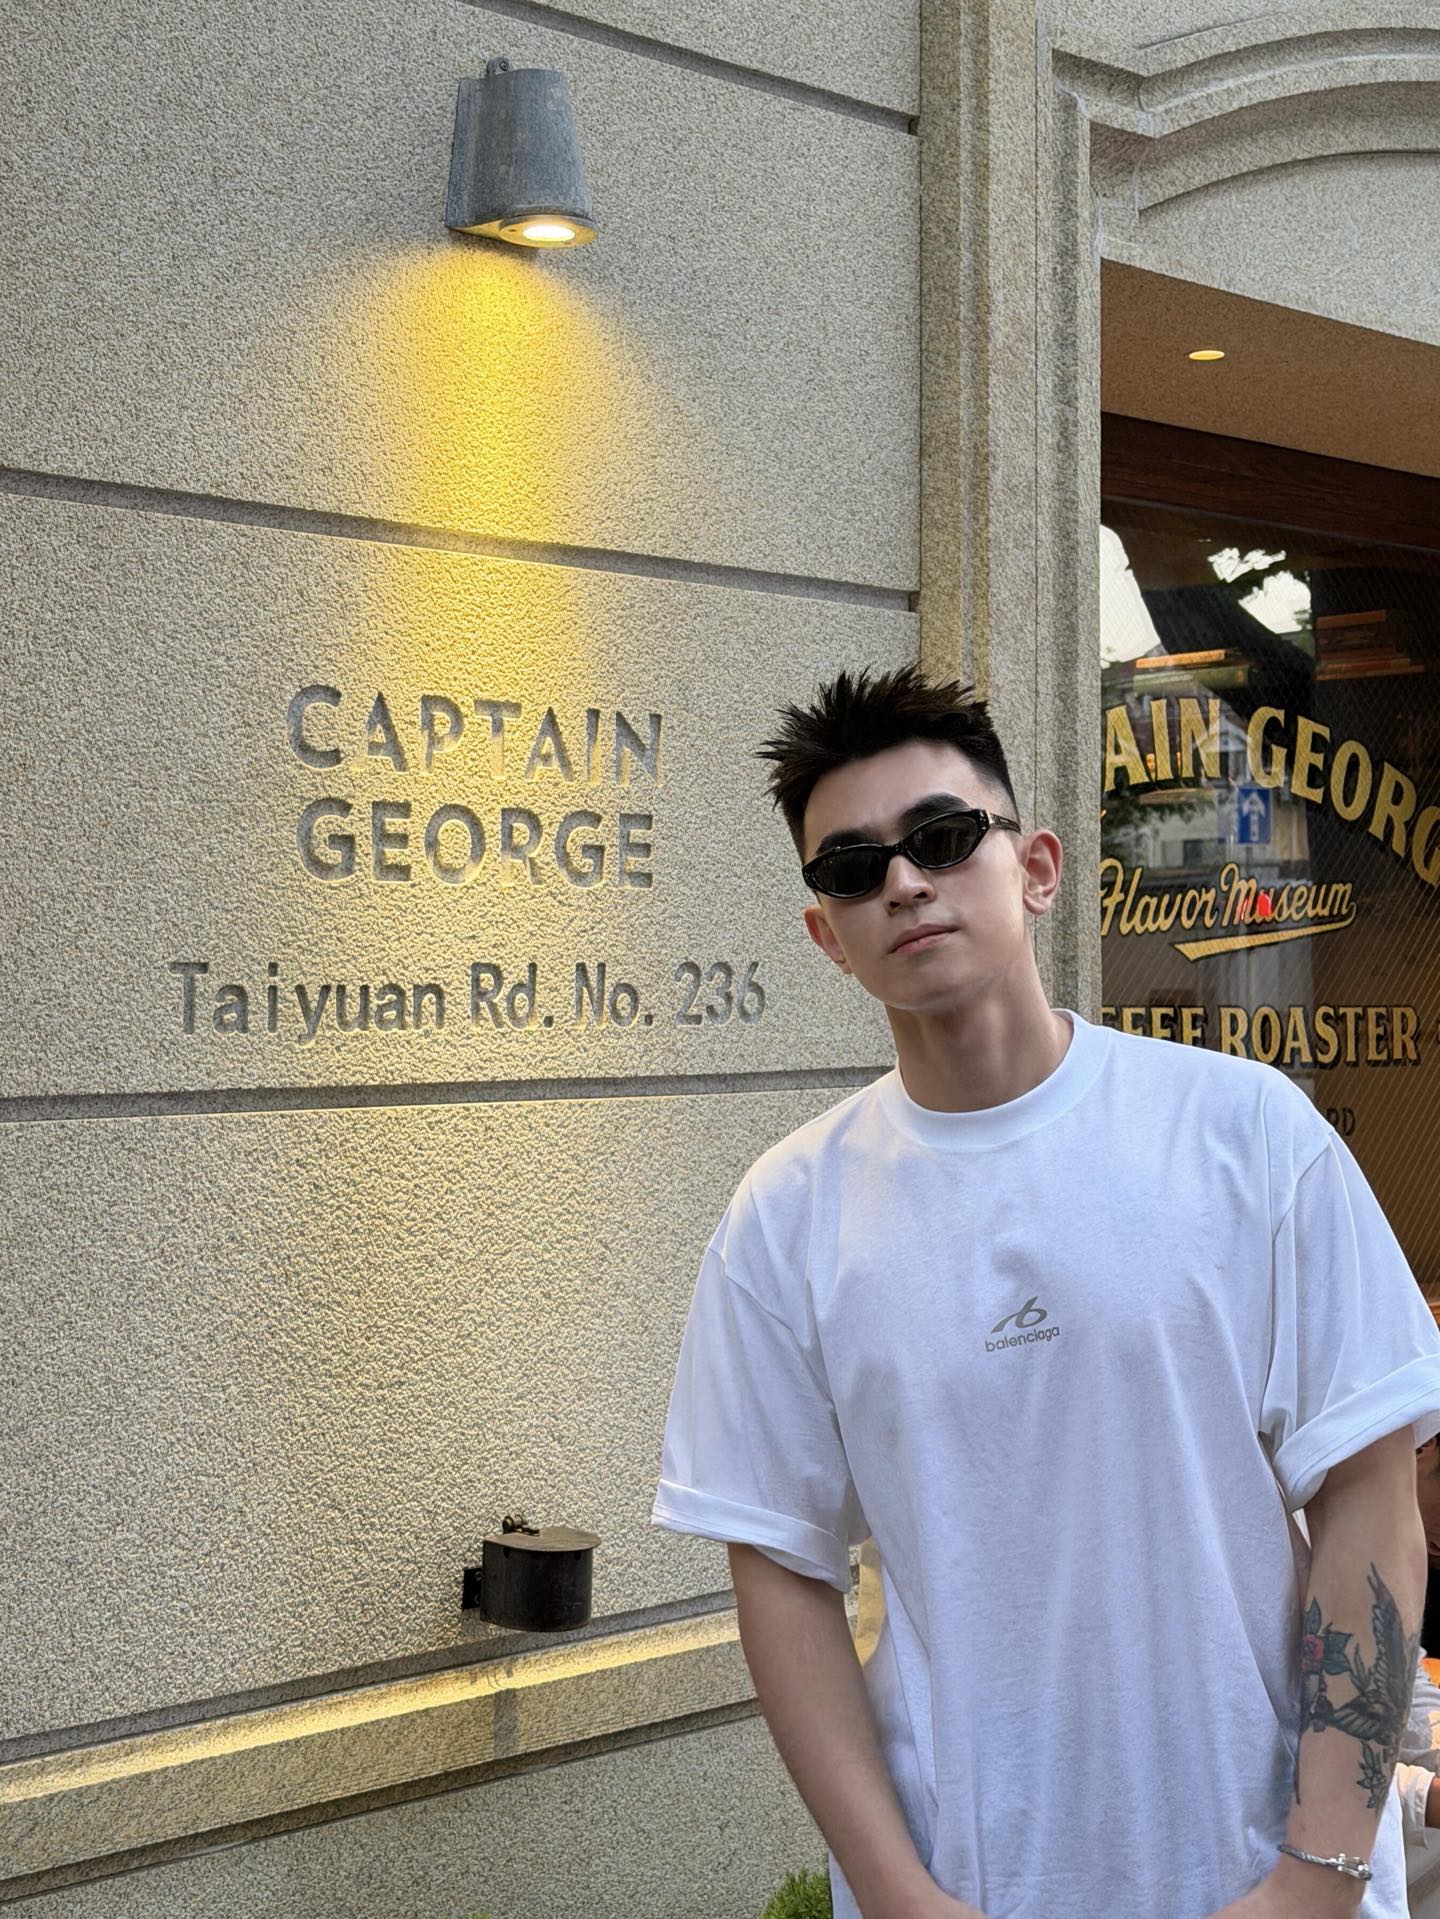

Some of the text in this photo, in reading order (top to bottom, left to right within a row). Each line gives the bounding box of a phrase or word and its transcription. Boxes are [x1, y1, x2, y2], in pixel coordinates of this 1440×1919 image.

[287, 684, 663, 787] CAPTAIN
[1103, 697, 1221, 792] AIN
[298, 797, 653, 889] GEORGE
[1100, 858, 1356, 936] Flavor Museum
[169, 960, 767, 1048] Taiyuan Rd. No. 236
[1219, 1005, 1418, 1064] ROASTER
[985, 1326, 1060, 1352] balenciaga
